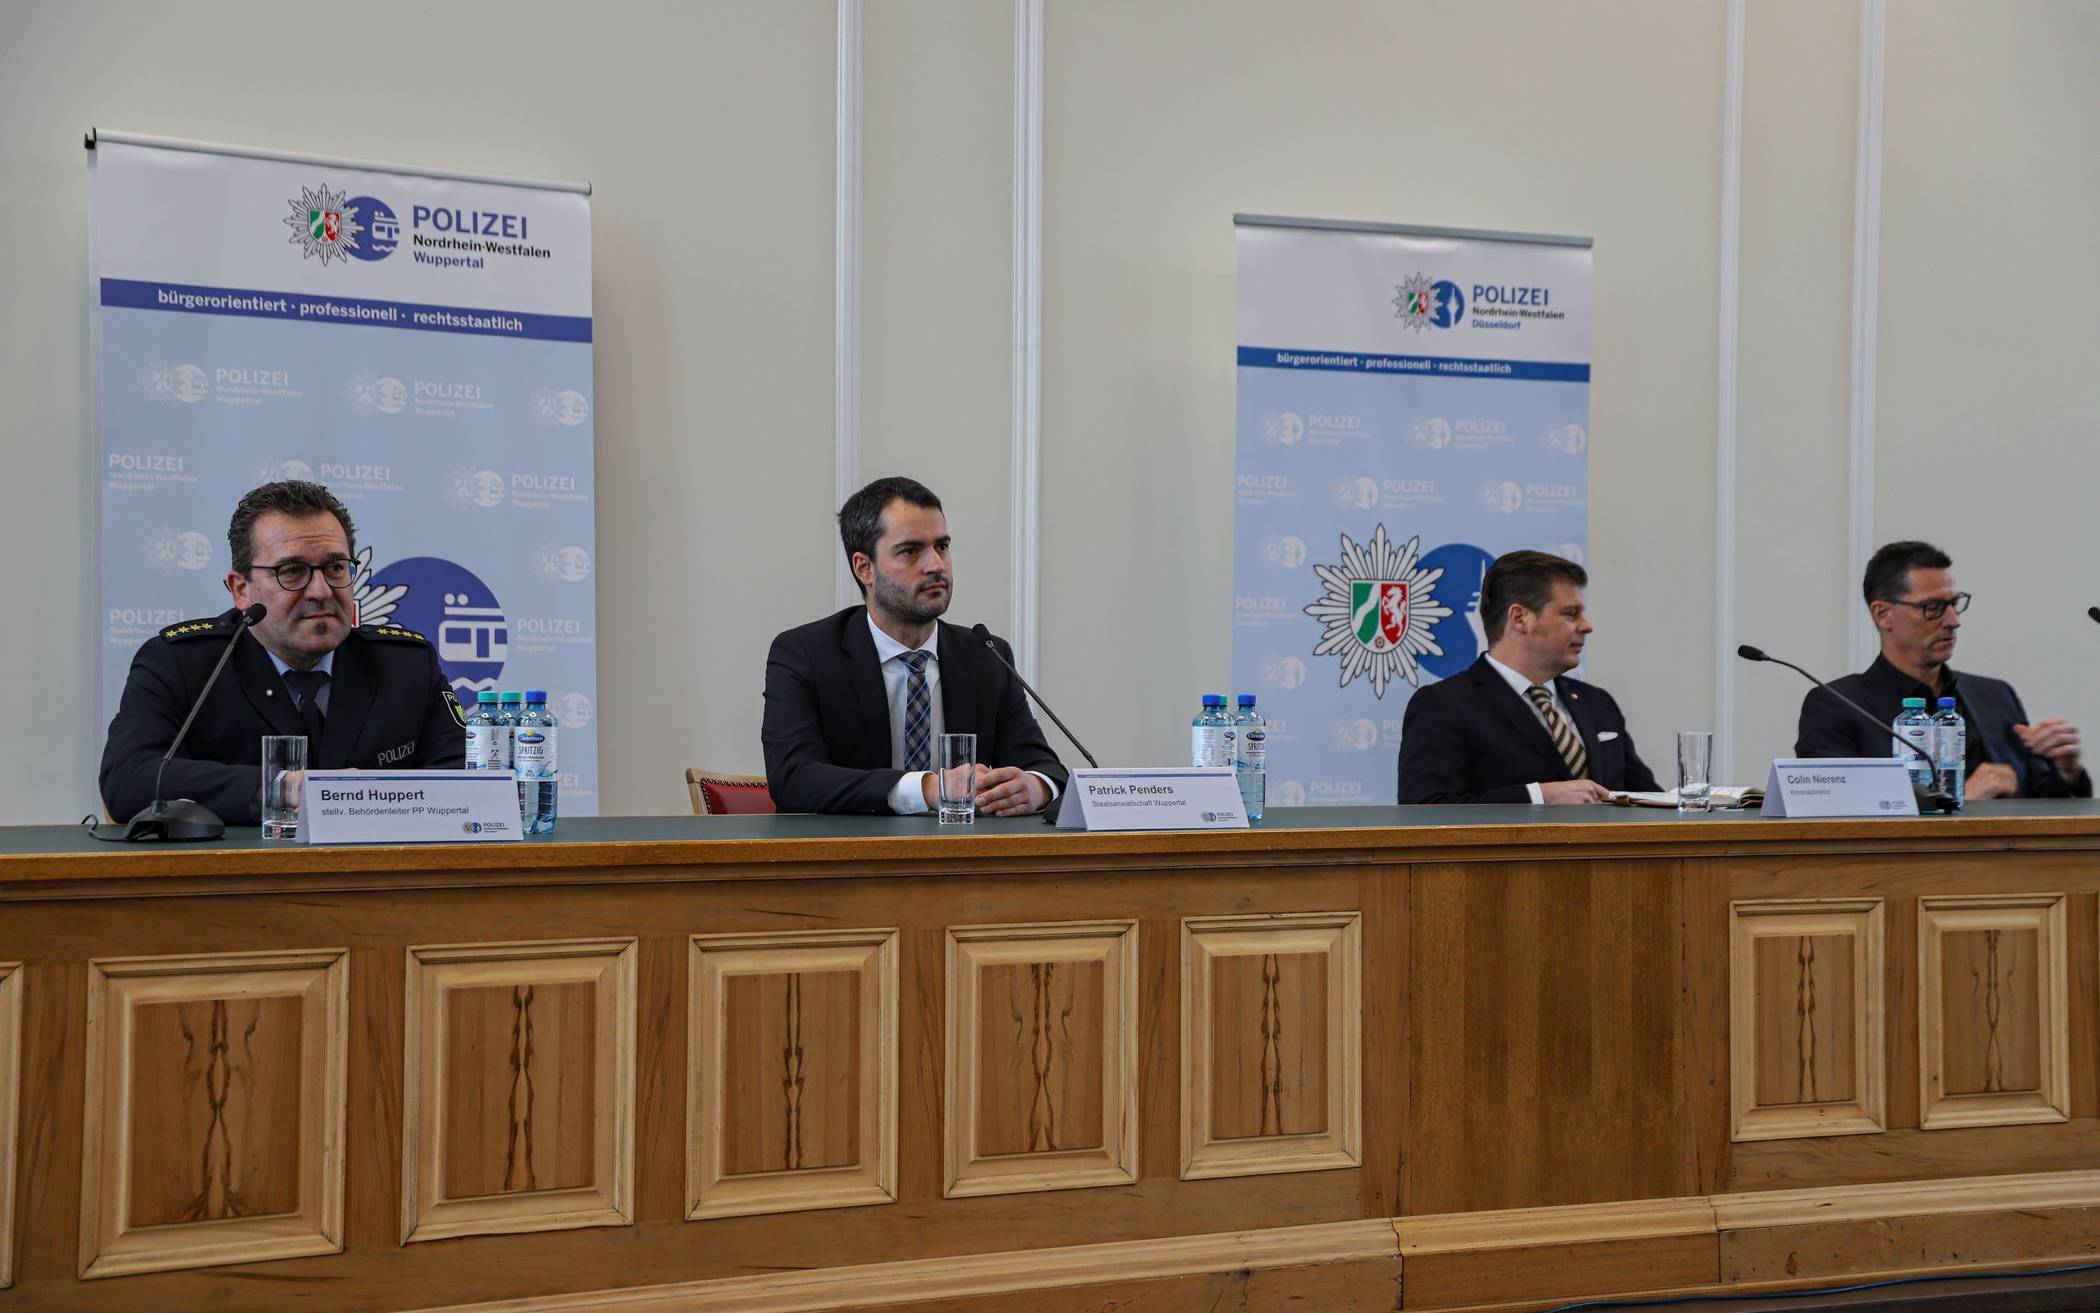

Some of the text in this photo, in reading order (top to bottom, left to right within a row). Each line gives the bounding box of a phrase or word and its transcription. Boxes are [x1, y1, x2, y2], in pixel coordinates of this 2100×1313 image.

[413, 205, 527, 239] POLIZEI
[413, 234, 551, 259] Nordrhein-Westfalen
[413, 251, 484, 269] Wuppertal
[1473, 285, 1549, 306] POLIZEI
[158, 289, 524, 333] bürgerorientiert professionell rechtsstaatlich
[1472, 306, 1565, 320] Nordrhein-Westfalen
[1472, 319, 1520, 330] Düsseldorf
[1277, 353, 1512, 374] bürgerorientiert professionell rechtsstaatlich
[216, 368, 289, 387] POLIZEI
[414, 381, 481, 401] POLIZEI
[1309, 415, 1361, 429] POLIZEI
[1455, 420, 1506, 433] POLIZEI
[108, 454, 183, 473] POLIZEI
[320, 464, 391, 481] POLIZEI
[511, 473, 576, 492] POLIZEI
[1238, 474, 1288, 489] POLIZEI
[1383, 480, 1435, 493] POLIZEI
[1526, 484, 1577, 497] POLIZEI
[1235, 597, 1287, 610] POLIZEI
[108, 608, 185, 625] POLIZEI
[516, 618, 581, 634] POLIZEI
[377, 740, 415, 767] POLIZEI
[518, 746, 544, 755] SPRITZIG
[1311, 781, 1361, 793] POLIZEI
[1787, 774, 1847, 785] Colin Nierenz
[321, 789, 425, 803] Bernd Huppert
[1088, 784, 1174, 795] Patrick Penders
[321, 805, 470, 816] stellv. Behördenleiter PP Wuppertal
[1153, 799, 1187, 809] Wuppertal
